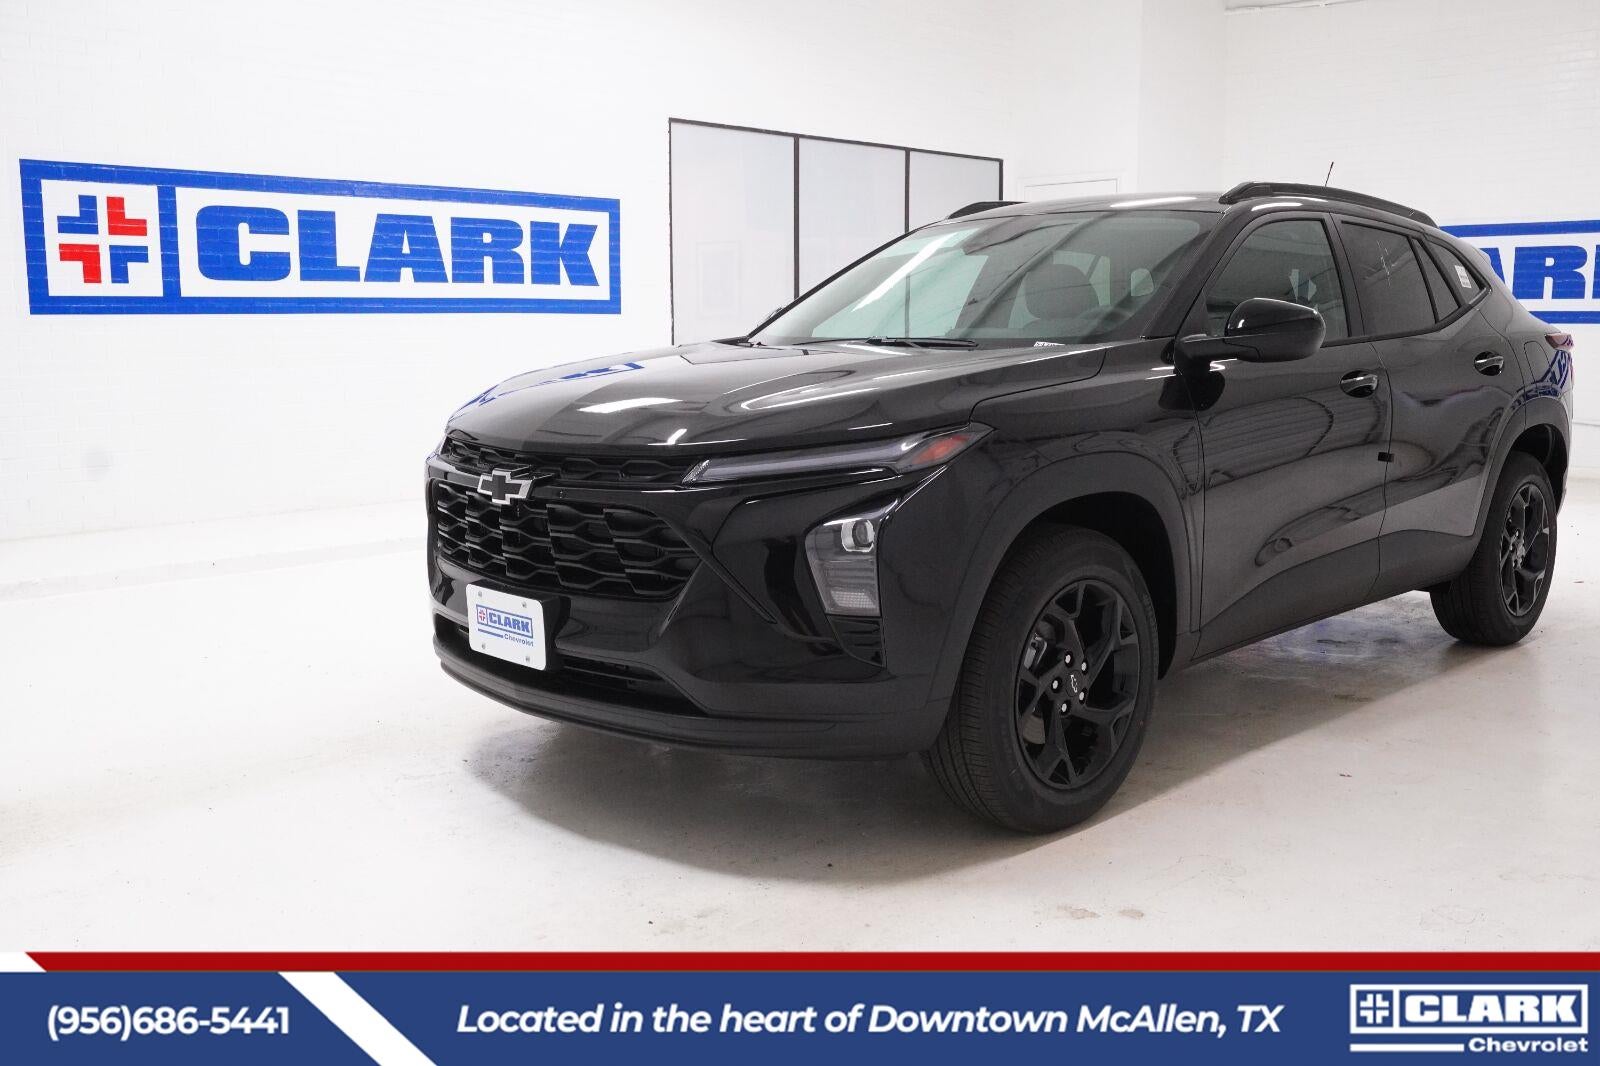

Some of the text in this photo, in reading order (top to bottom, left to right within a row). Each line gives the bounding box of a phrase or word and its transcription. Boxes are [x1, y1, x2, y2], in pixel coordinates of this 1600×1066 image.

[196, 205, 600, 287] CLARK
[488, 612, 530, 633] CLARK
[503, 633, 534, 647] Chevrolet
